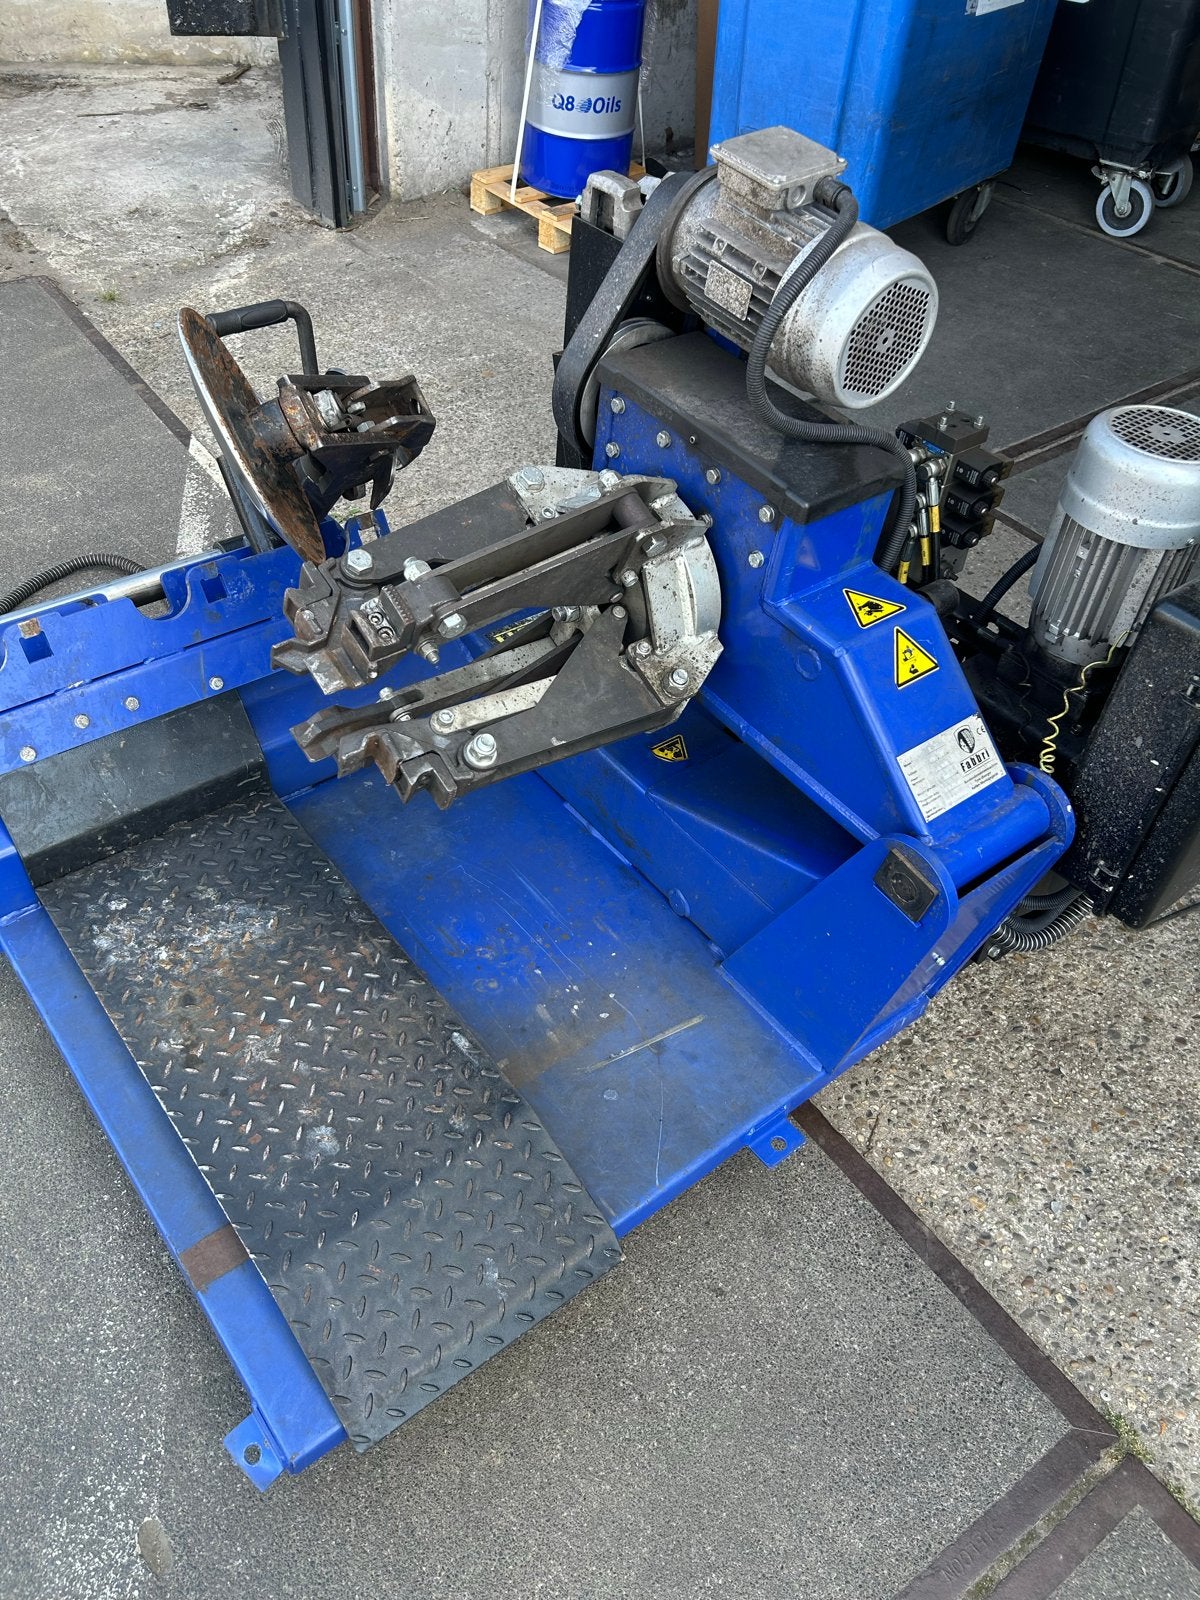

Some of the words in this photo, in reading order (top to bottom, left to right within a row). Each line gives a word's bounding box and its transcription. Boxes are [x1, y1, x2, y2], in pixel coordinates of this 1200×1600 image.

[552, 93, 575, 112] Q8
[592, 96, 621, 114] Oils
[960, 748, 990, 772] Fabbri
